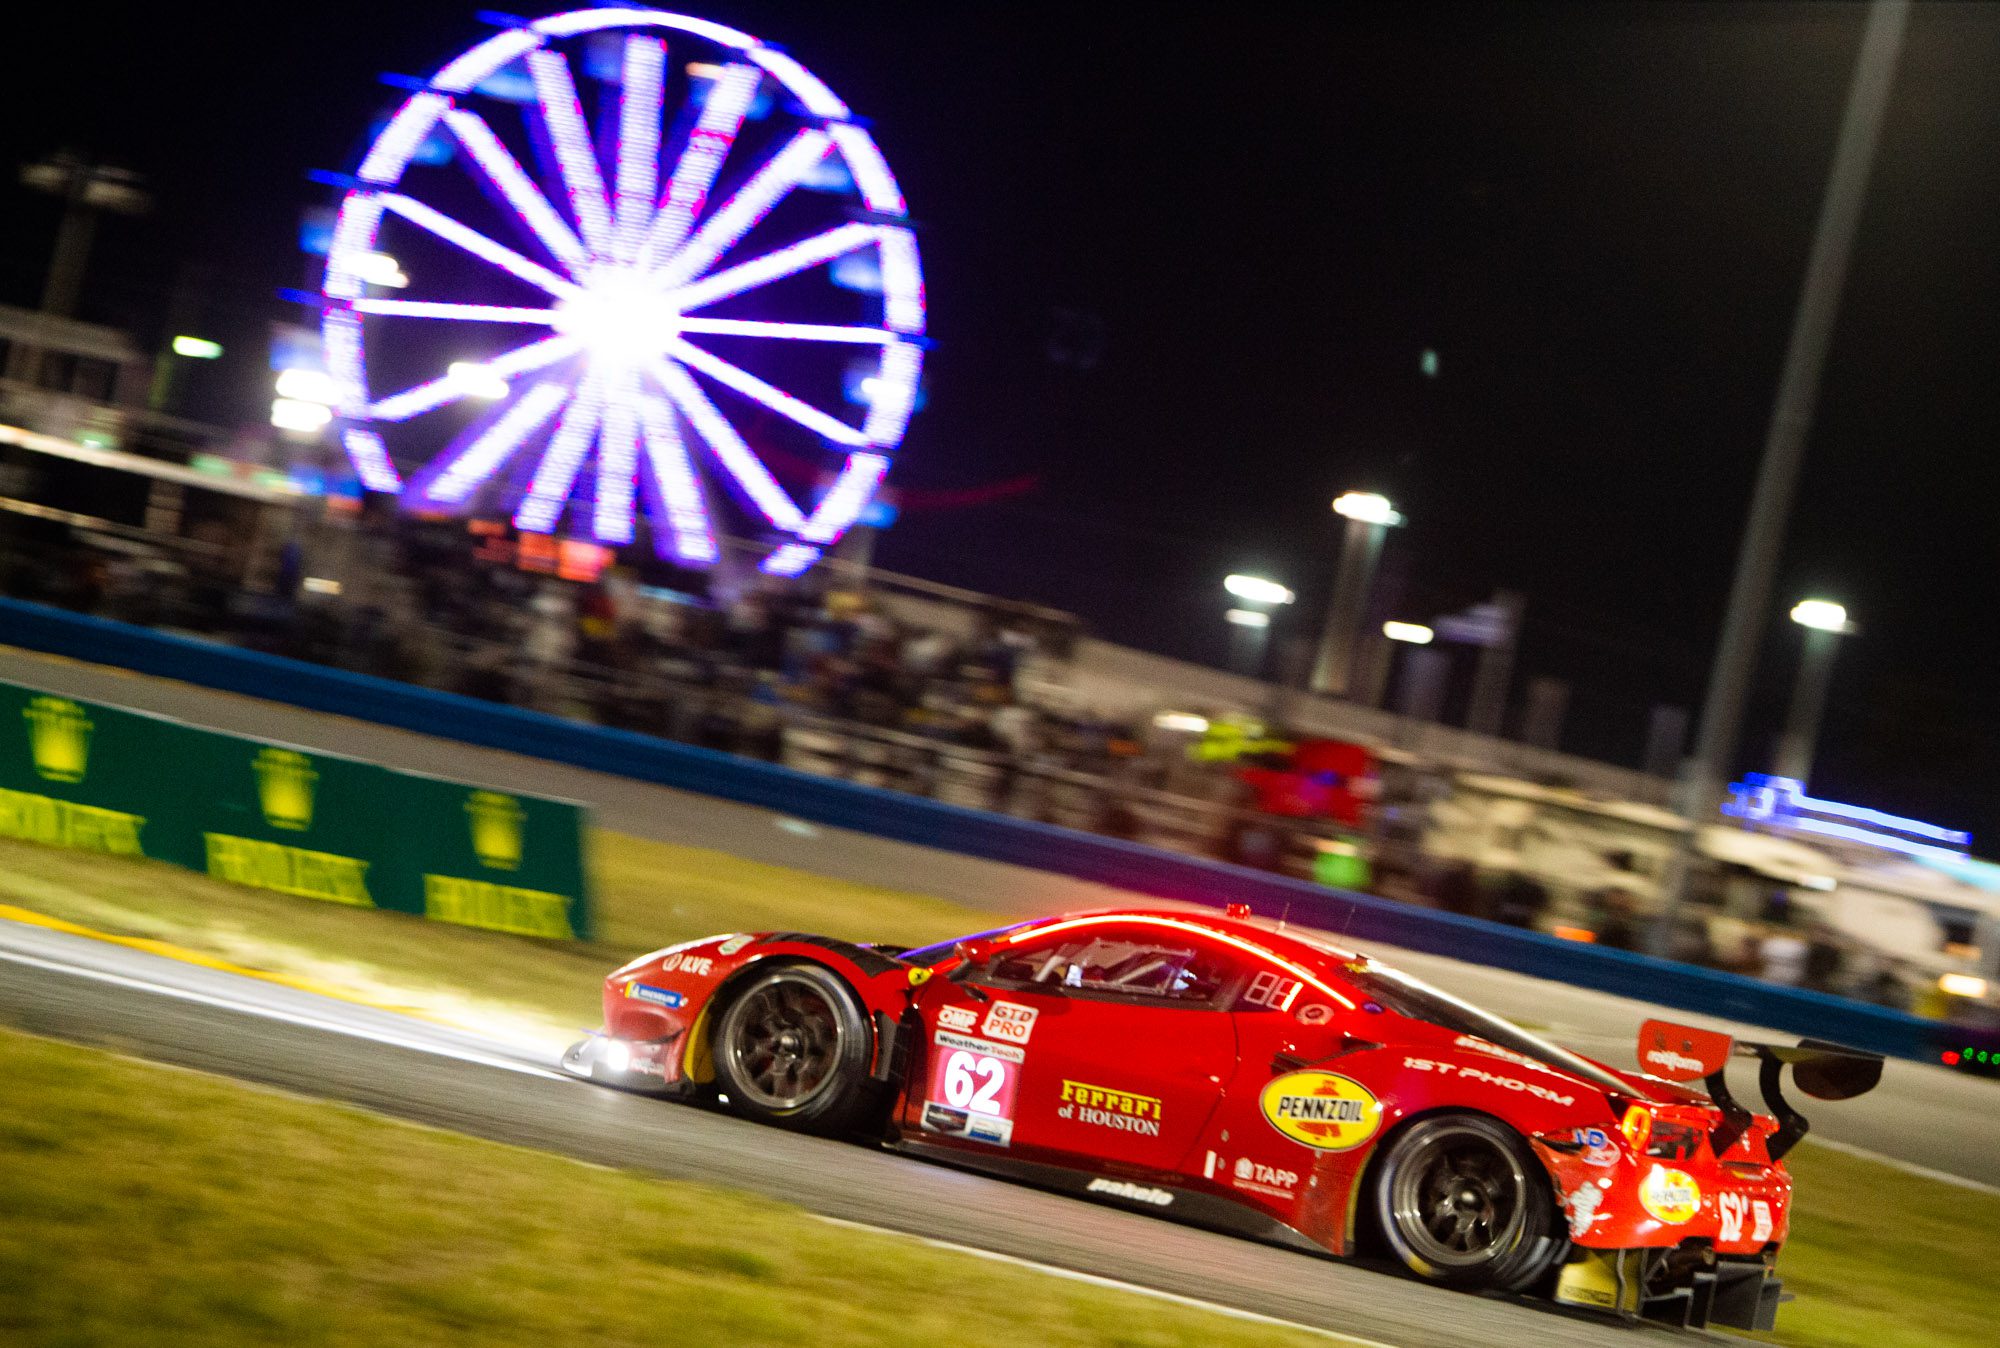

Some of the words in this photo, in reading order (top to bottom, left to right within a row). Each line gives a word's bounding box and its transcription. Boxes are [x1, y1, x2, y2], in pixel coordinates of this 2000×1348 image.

[939, 1008, 977, 1028] OMP
[994, 1005, 1033, 1022] GTD
[988, 1018, 1026, 1038] PRO
[944, 1050, 1001, 1116] 62
[1060, 1079, 1162, 1120] Ferrari
[1276, 1095, 1366, 1123] PENNZOIL
[1058, 1103, 1075, 1119] of
[1078, 1105, 1160, 1137] HOUSTON
[1254, 1163, 1299, 1189] TAPP
